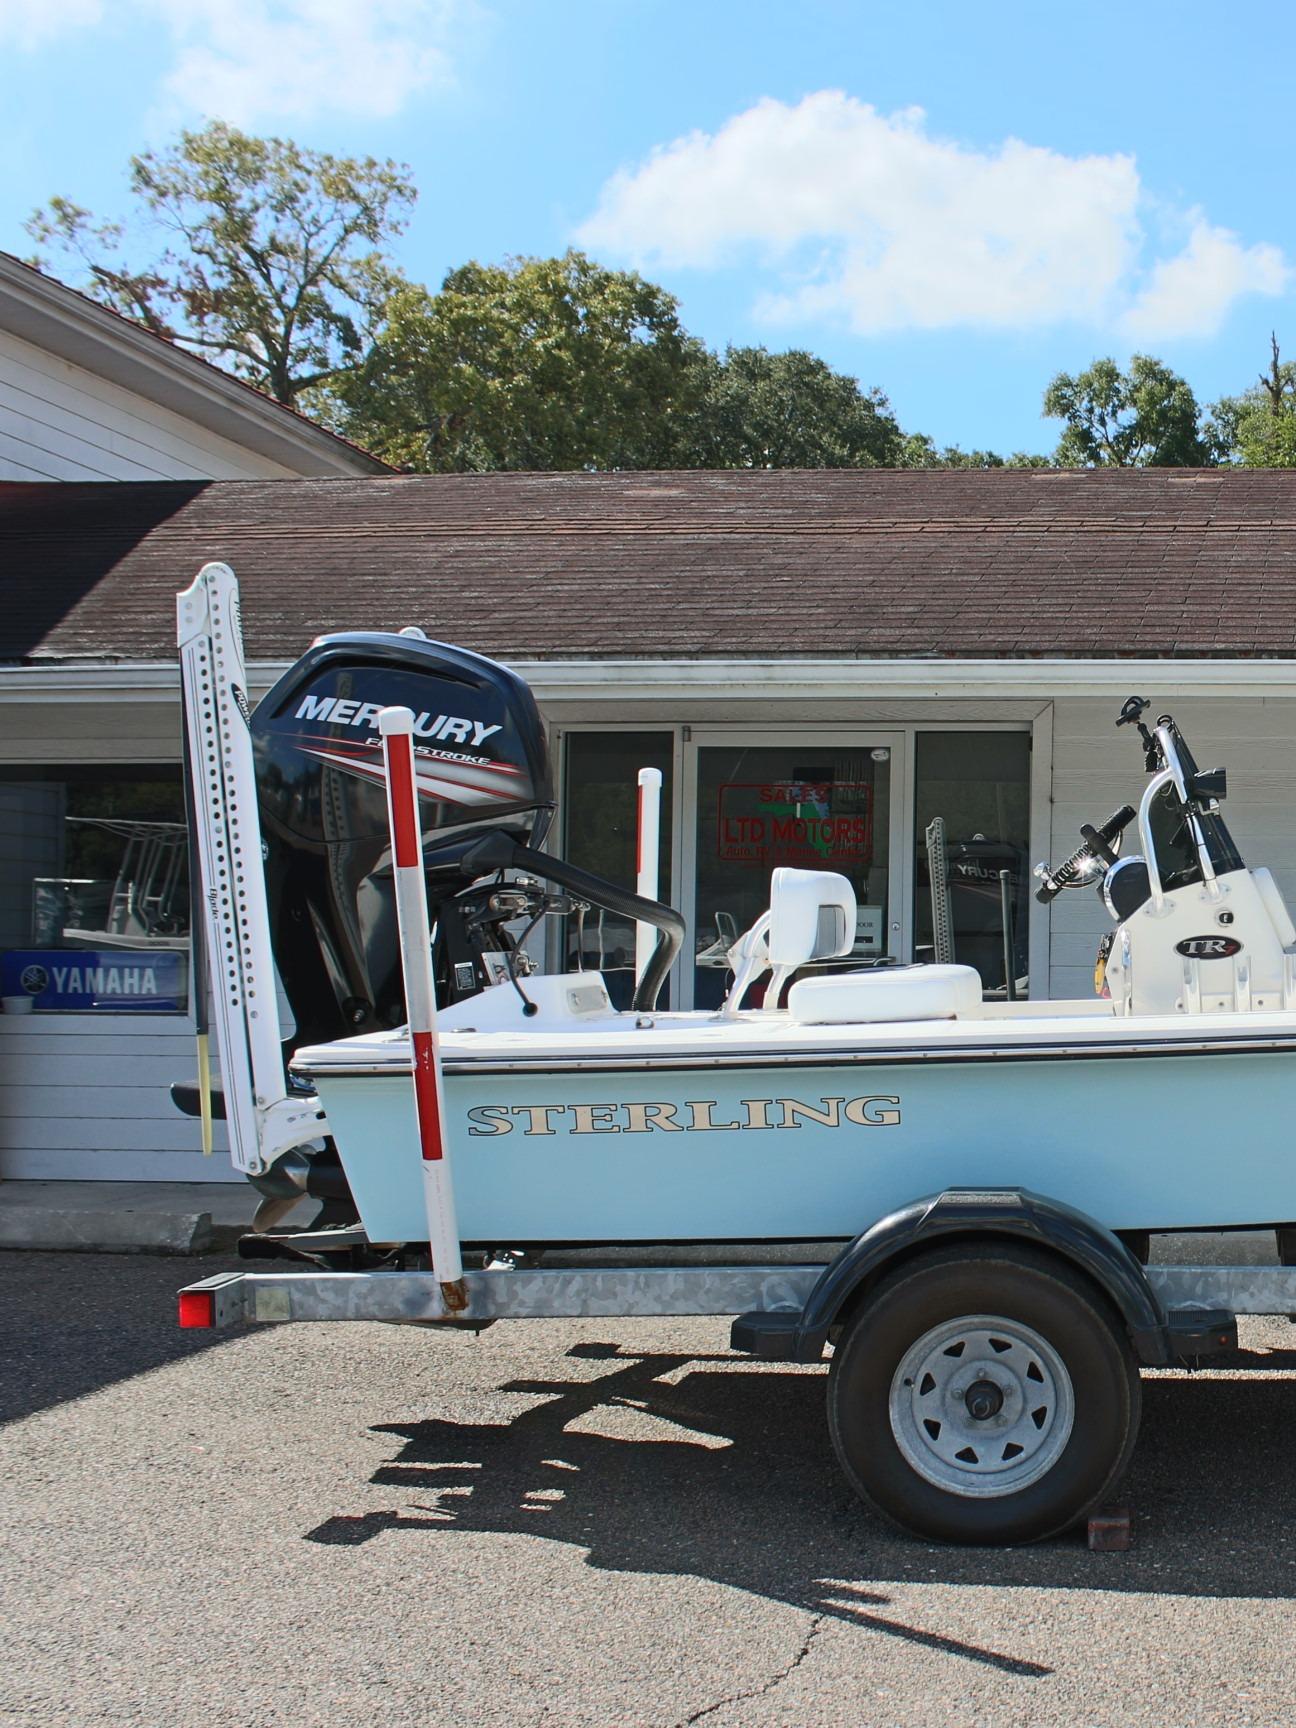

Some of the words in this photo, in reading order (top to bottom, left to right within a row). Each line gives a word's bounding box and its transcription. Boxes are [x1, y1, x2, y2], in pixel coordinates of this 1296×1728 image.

[294, 695, 503, 746] MERURY
[759, 788, 829, 803] SALES
[724, 817, 765, 843] LTD
[772, 817, 865, 844] MOTORS
[208, 888, 219, 919] Blade
[52, 967, 157, 994] YAMAHA
[467, 1095, 901, 1136] STERLING
